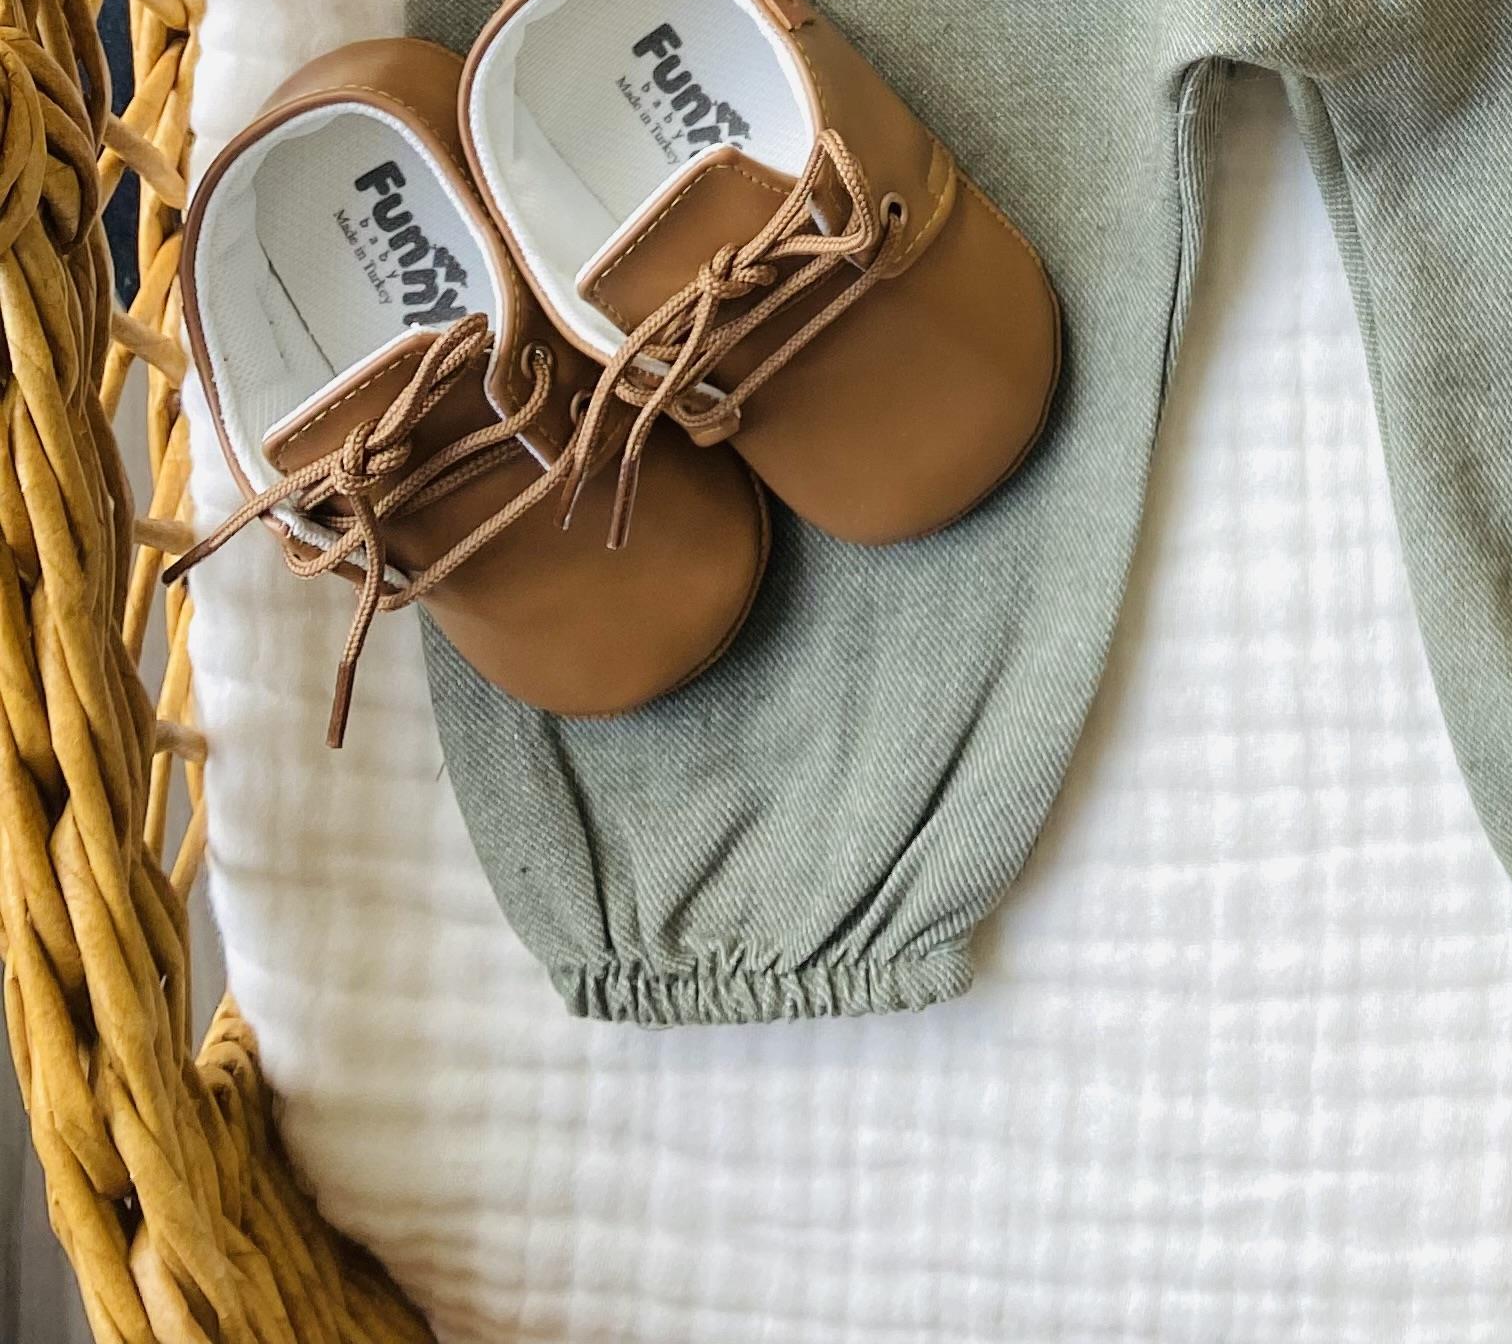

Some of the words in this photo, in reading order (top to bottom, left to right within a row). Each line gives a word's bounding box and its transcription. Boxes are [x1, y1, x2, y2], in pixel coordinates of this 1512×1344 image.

[615, 75, 642, 111] Made
[639, 112, 653, 127] in
[650, 121, 681, 165] Turkey
[332, 208, 359, 246] Made
[353, 246, 367, 262] in
[363, 258, 393, 306] Turkey
[354, 160, 468, 327] Funny
